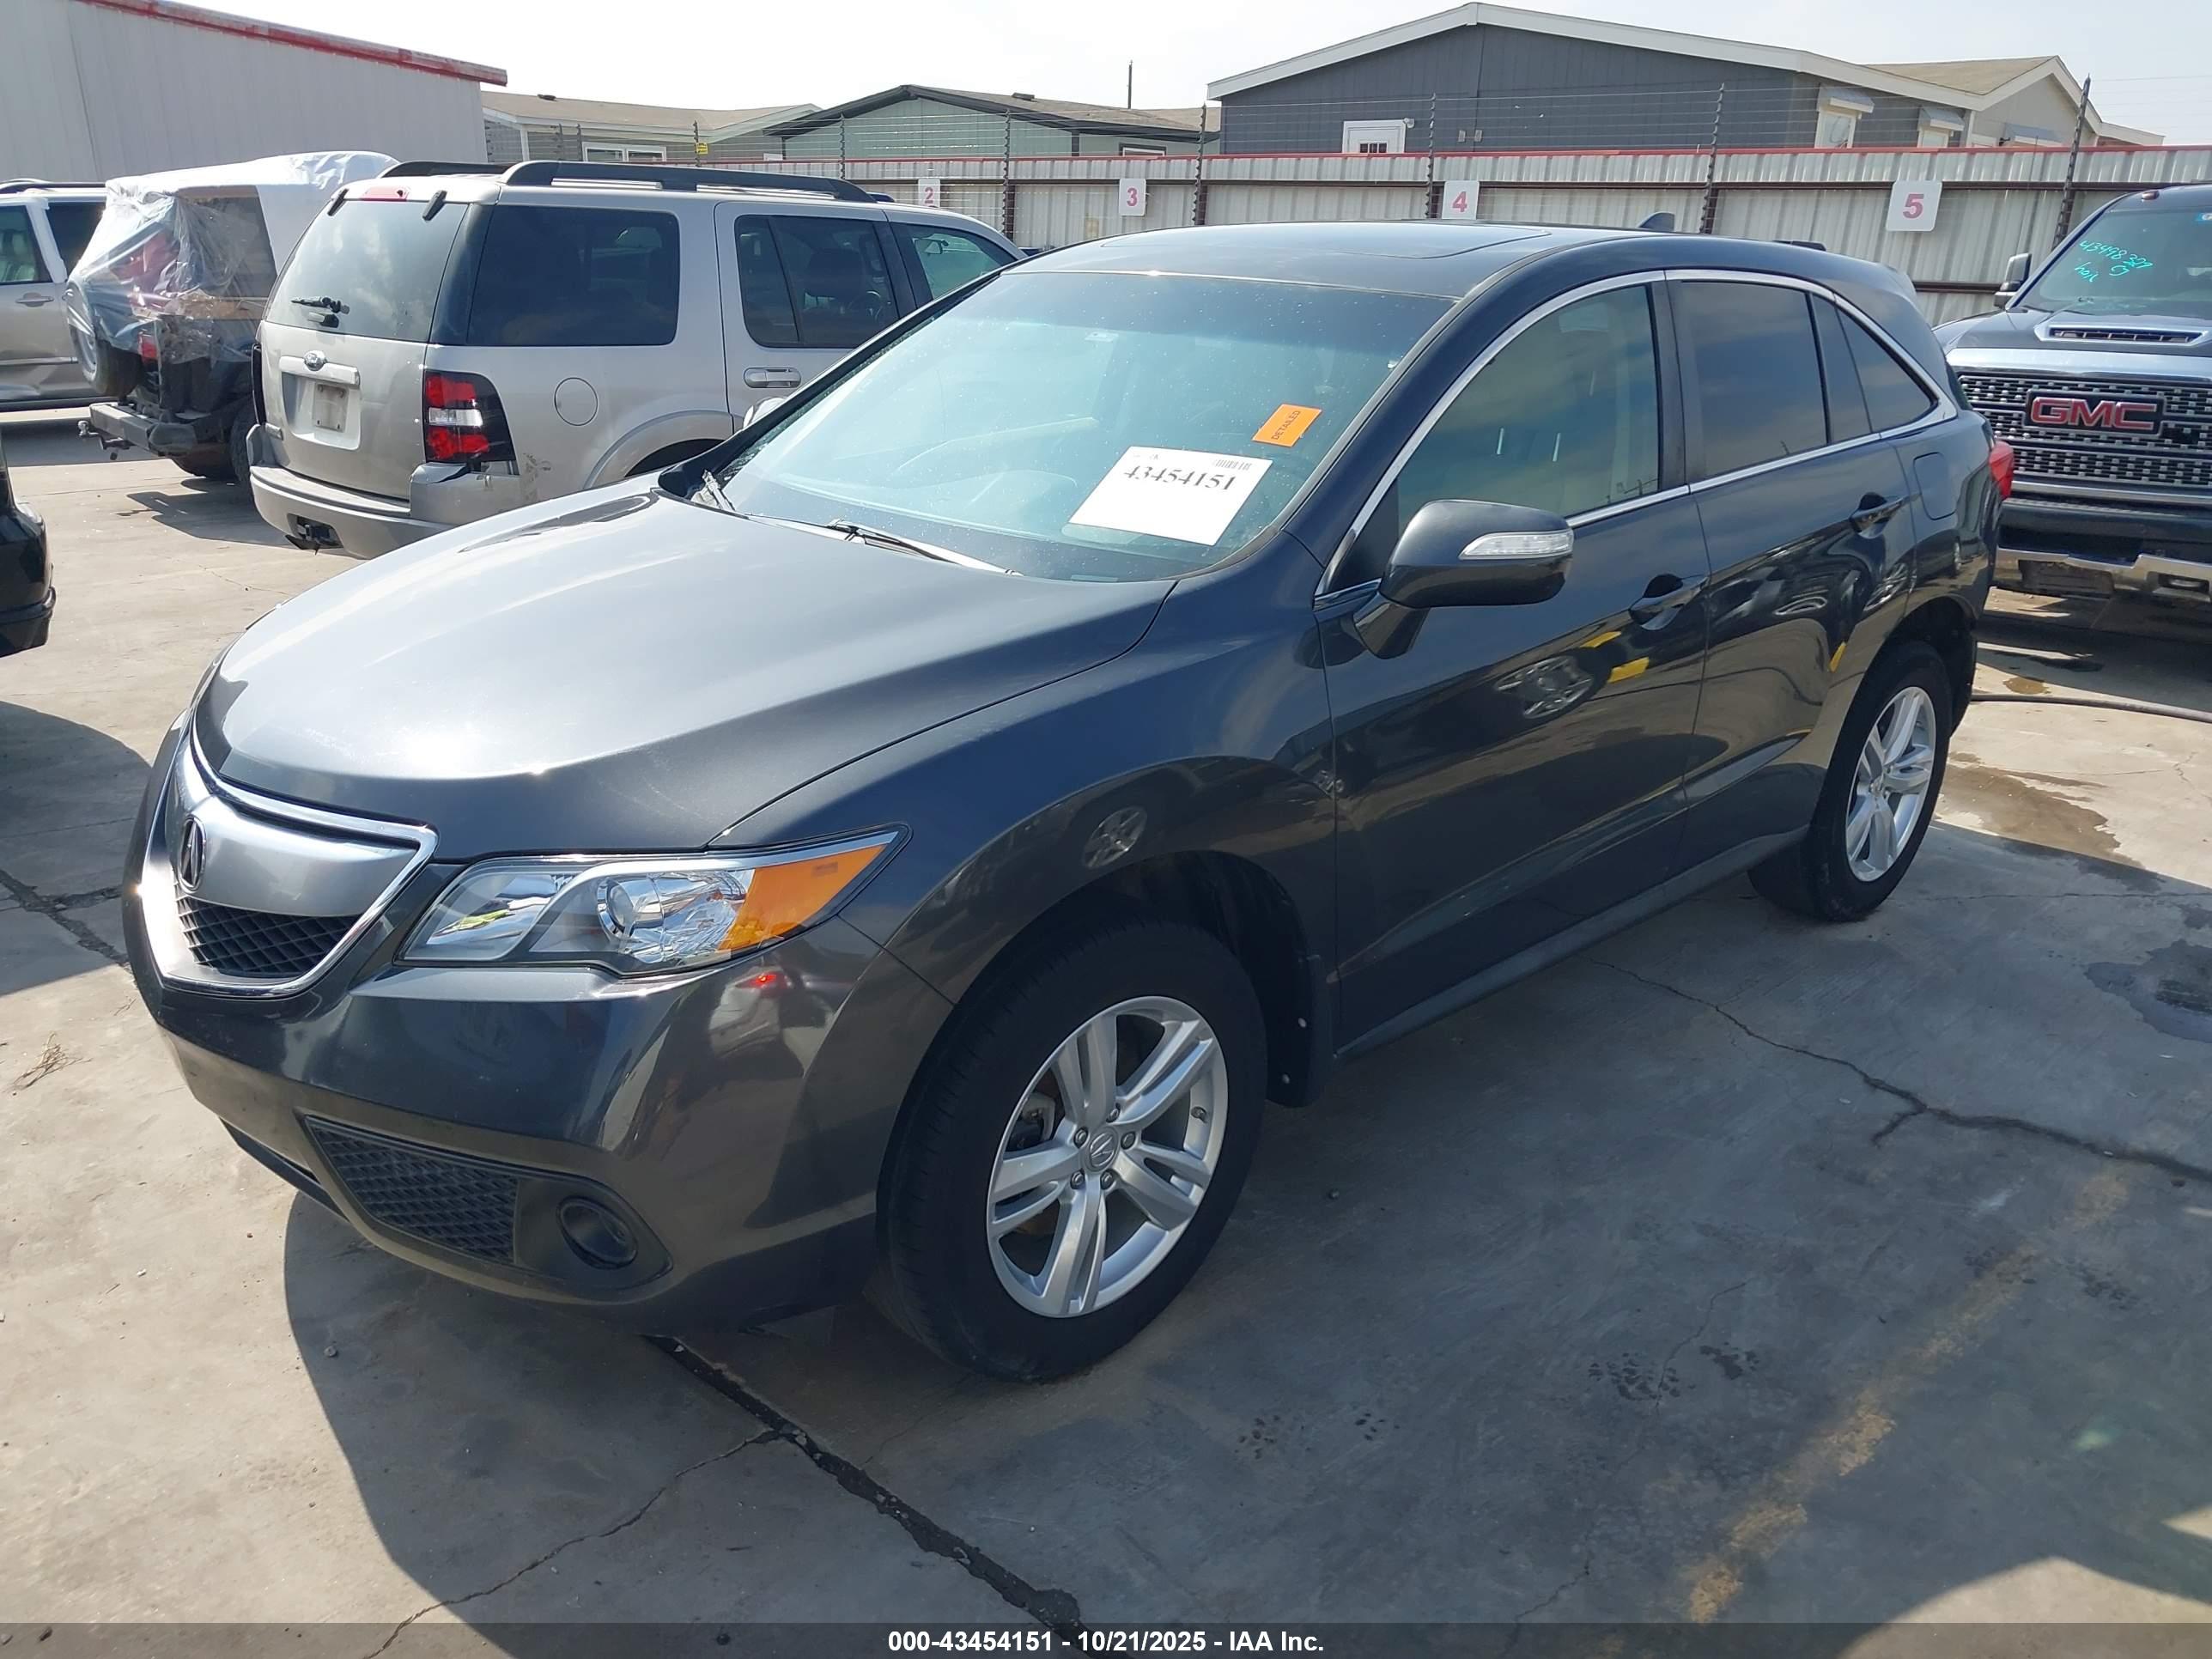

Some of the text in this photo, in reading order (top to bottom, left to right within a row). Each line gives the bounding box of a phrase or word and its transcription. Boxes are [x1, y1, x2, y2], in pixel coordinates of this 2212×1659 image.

[923, 186, 934, 204] 2
[1126, 187, 1138, 206] 3
[1452, 191, 1468, 212] 4
[1902, 193, 1924, 219] 5
[1271, 410, 1301, 440] DETAILED
[2031, 396, 2157, 430] GMC
[1123, 465, 1237, 491] 43454151
